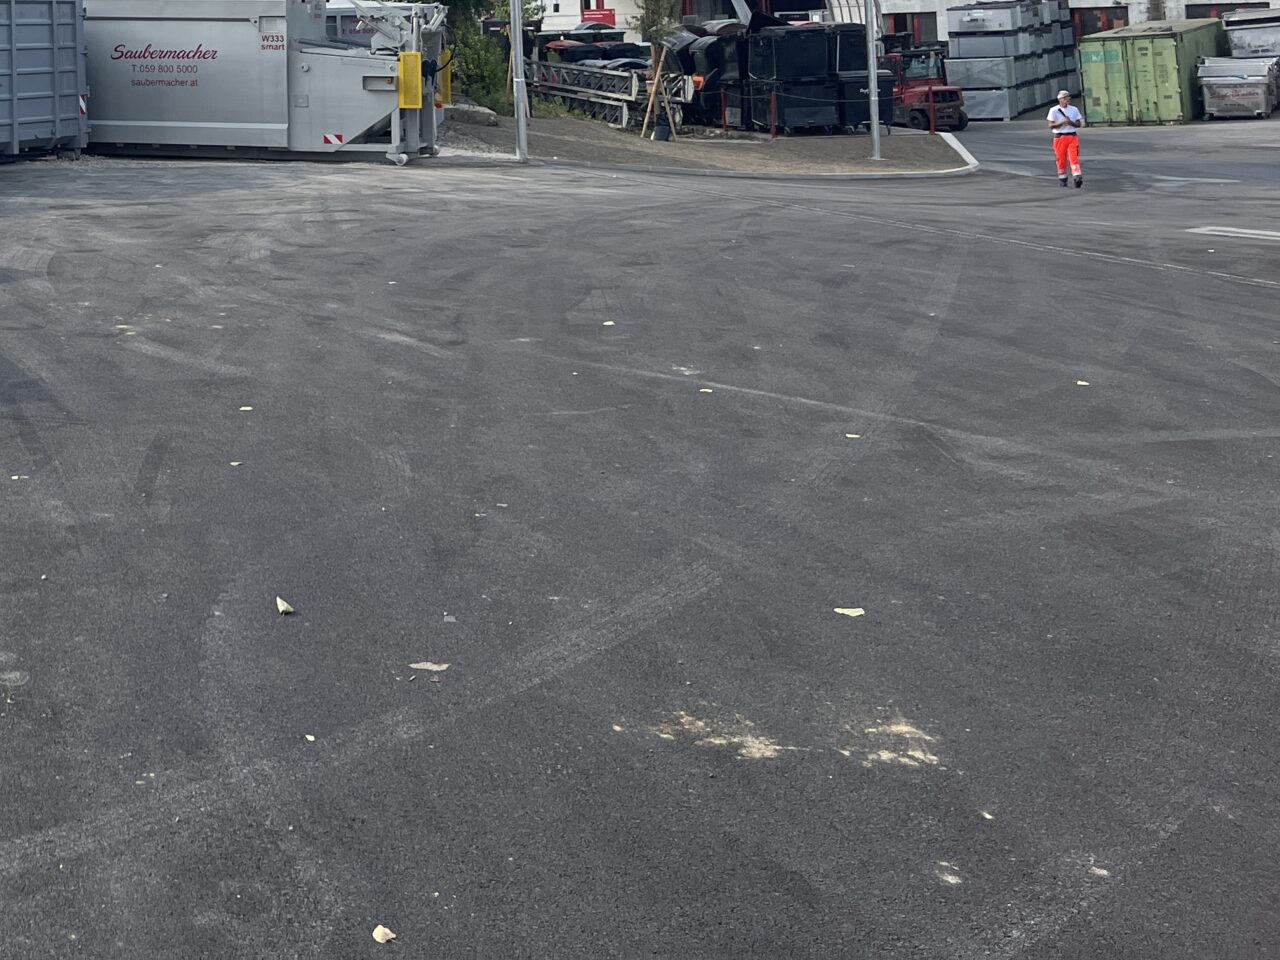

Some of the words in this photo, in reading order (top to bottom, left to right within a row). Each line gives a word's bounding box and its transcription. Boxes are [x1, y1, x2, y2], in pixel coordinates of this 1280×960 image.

[261, 35, 285, 43] W333
[110, 43, 218, 60] Saubermacher
[261, 43, 285, 51] smart
[158, 64, 174, 73] 800
[176, 64, 198, 74] 5000
[131, 78, 198, 87] saubermacher.at
